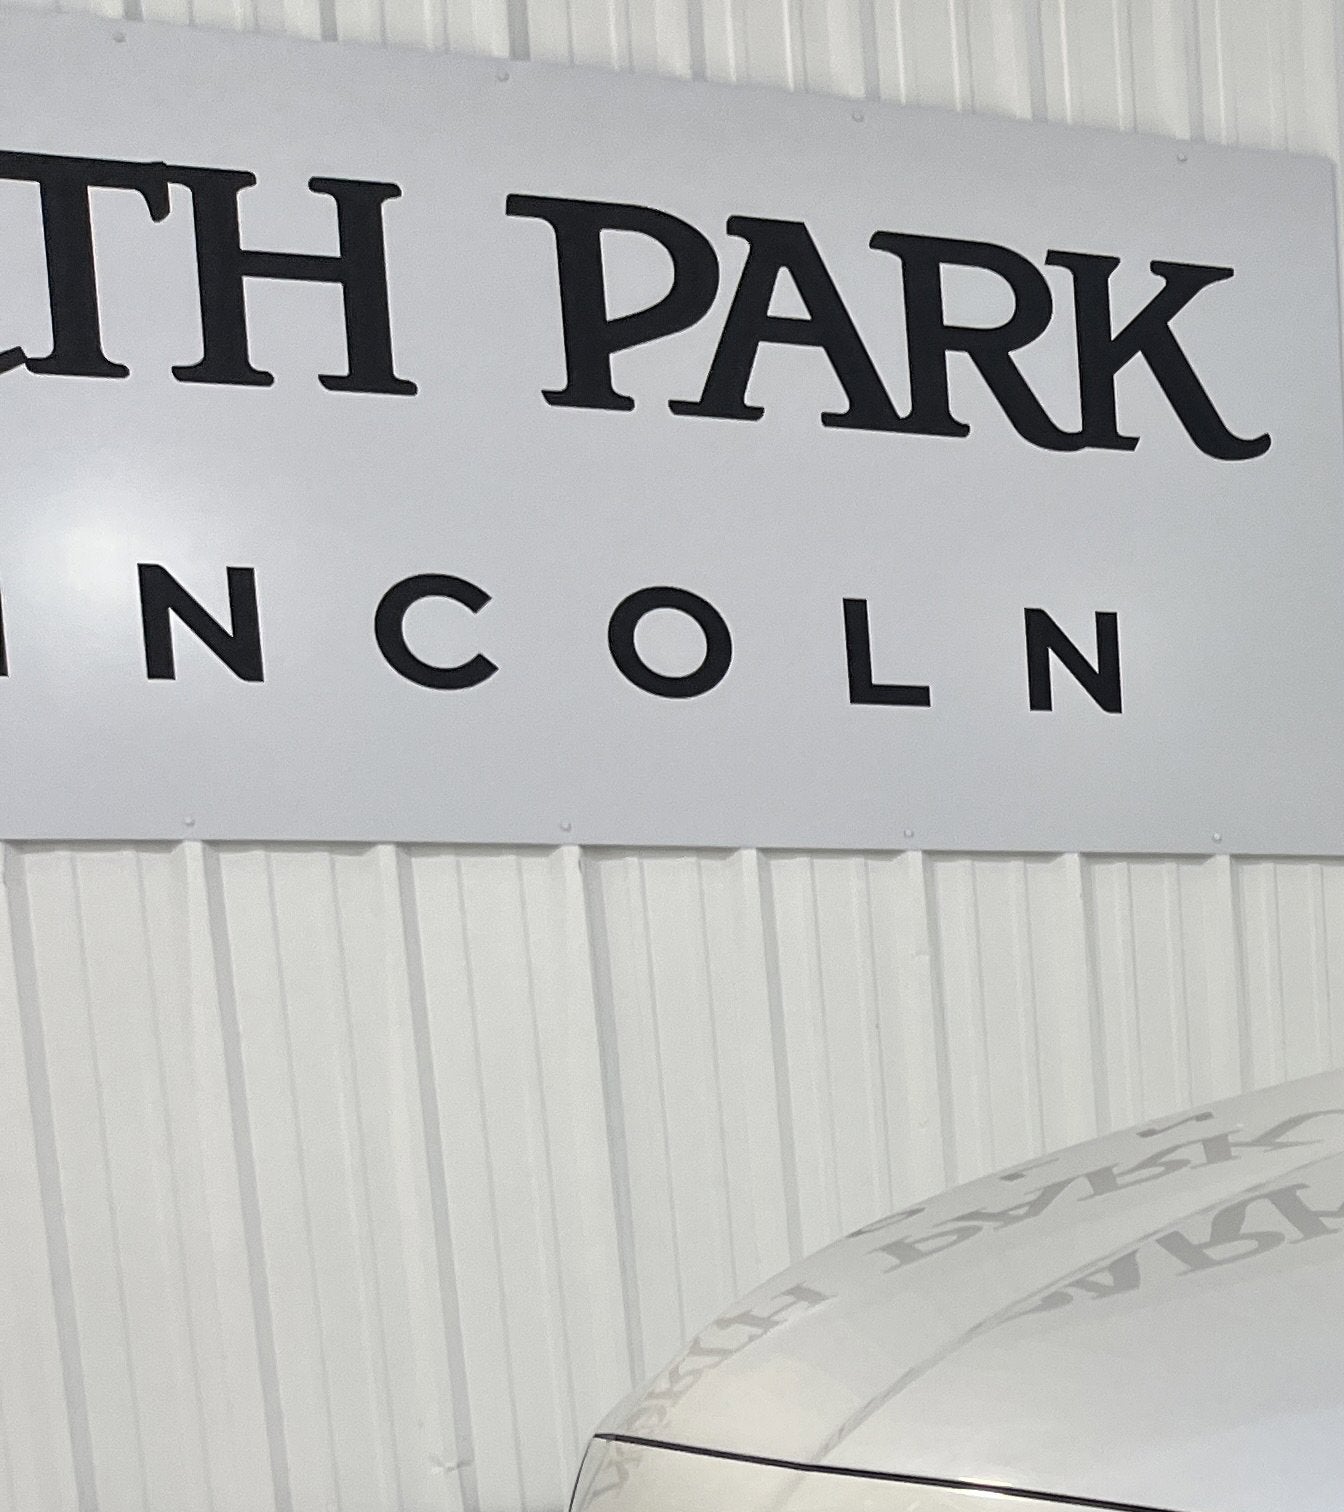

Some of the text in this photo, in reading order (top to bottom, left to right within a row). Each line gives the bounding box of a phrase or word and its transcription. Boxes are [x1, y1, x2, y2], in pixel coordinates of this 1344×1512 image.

[0, 148, 1272, 462] TH PARK
[0, 561, 1124, 714] NCOLN
